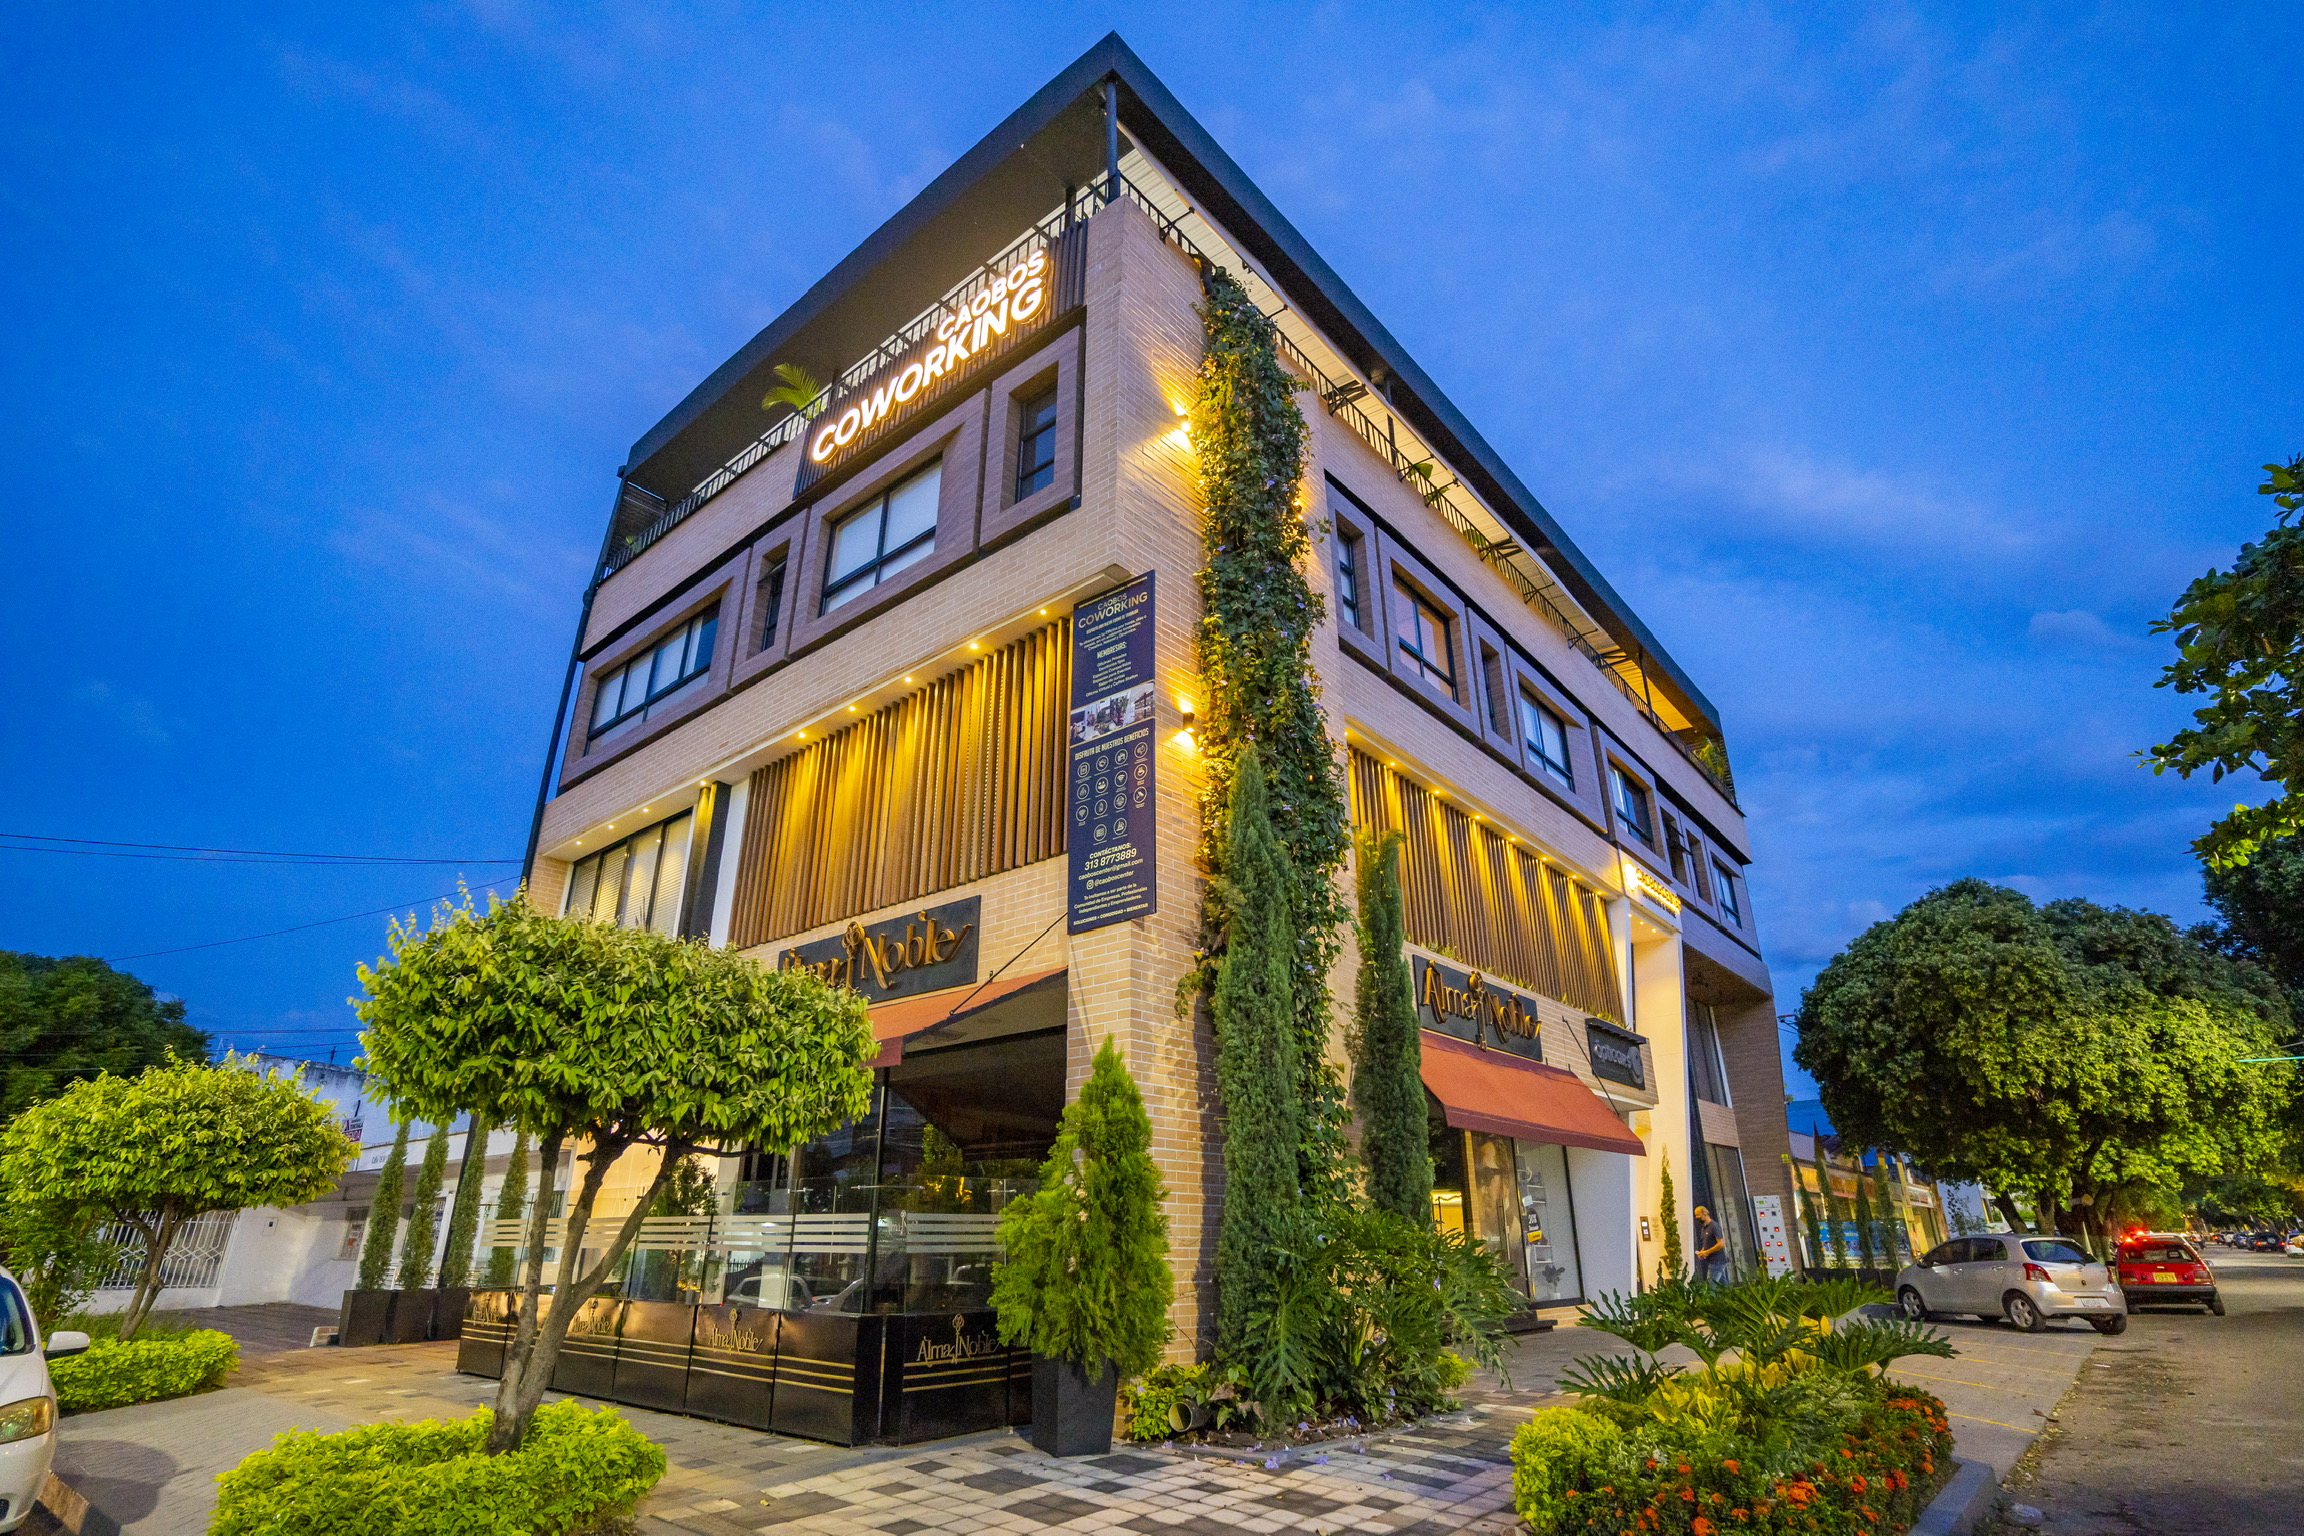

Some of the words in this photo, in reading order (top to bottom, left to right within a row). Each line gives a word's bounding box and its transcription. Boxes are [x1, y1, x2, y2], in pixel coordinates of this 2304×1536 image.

[936, 249, 1046, 342] CAOBOS
[811, 277, 1046, 463] COWORKING
[1078, 591, 1148, 628] COWORKING
[1097, 593, 1127, 610] CAOBOS
[1075, 747, 1095, 760] DISFRUTA
[1095, 744, 1101, 753] DE
[1101, 736, 1123, 751] NUESTROS
[1124, 728, 1149, 743] BENEFICIOS
[1084, 858, 1099, 871] 313
[1100, 848, 1137, 866] 8773889
[1089, 842, 1132, 859] CONTÁCTANOS:
[1078, 858, 1144, 880] caoboscenter@gmail.com
[1094, 870, 1135, 887] @caoboscenter
[861, 910, 973, 990] Noble
[1420, 959, 1478, 1025] Alma
[1484, 991, 1542, 1044] Noble
[732, 1327, 764, 1352] Noble
[916, 1335, 956, 1368] Alma
[957, 1330, 1000, 1360] Noble
